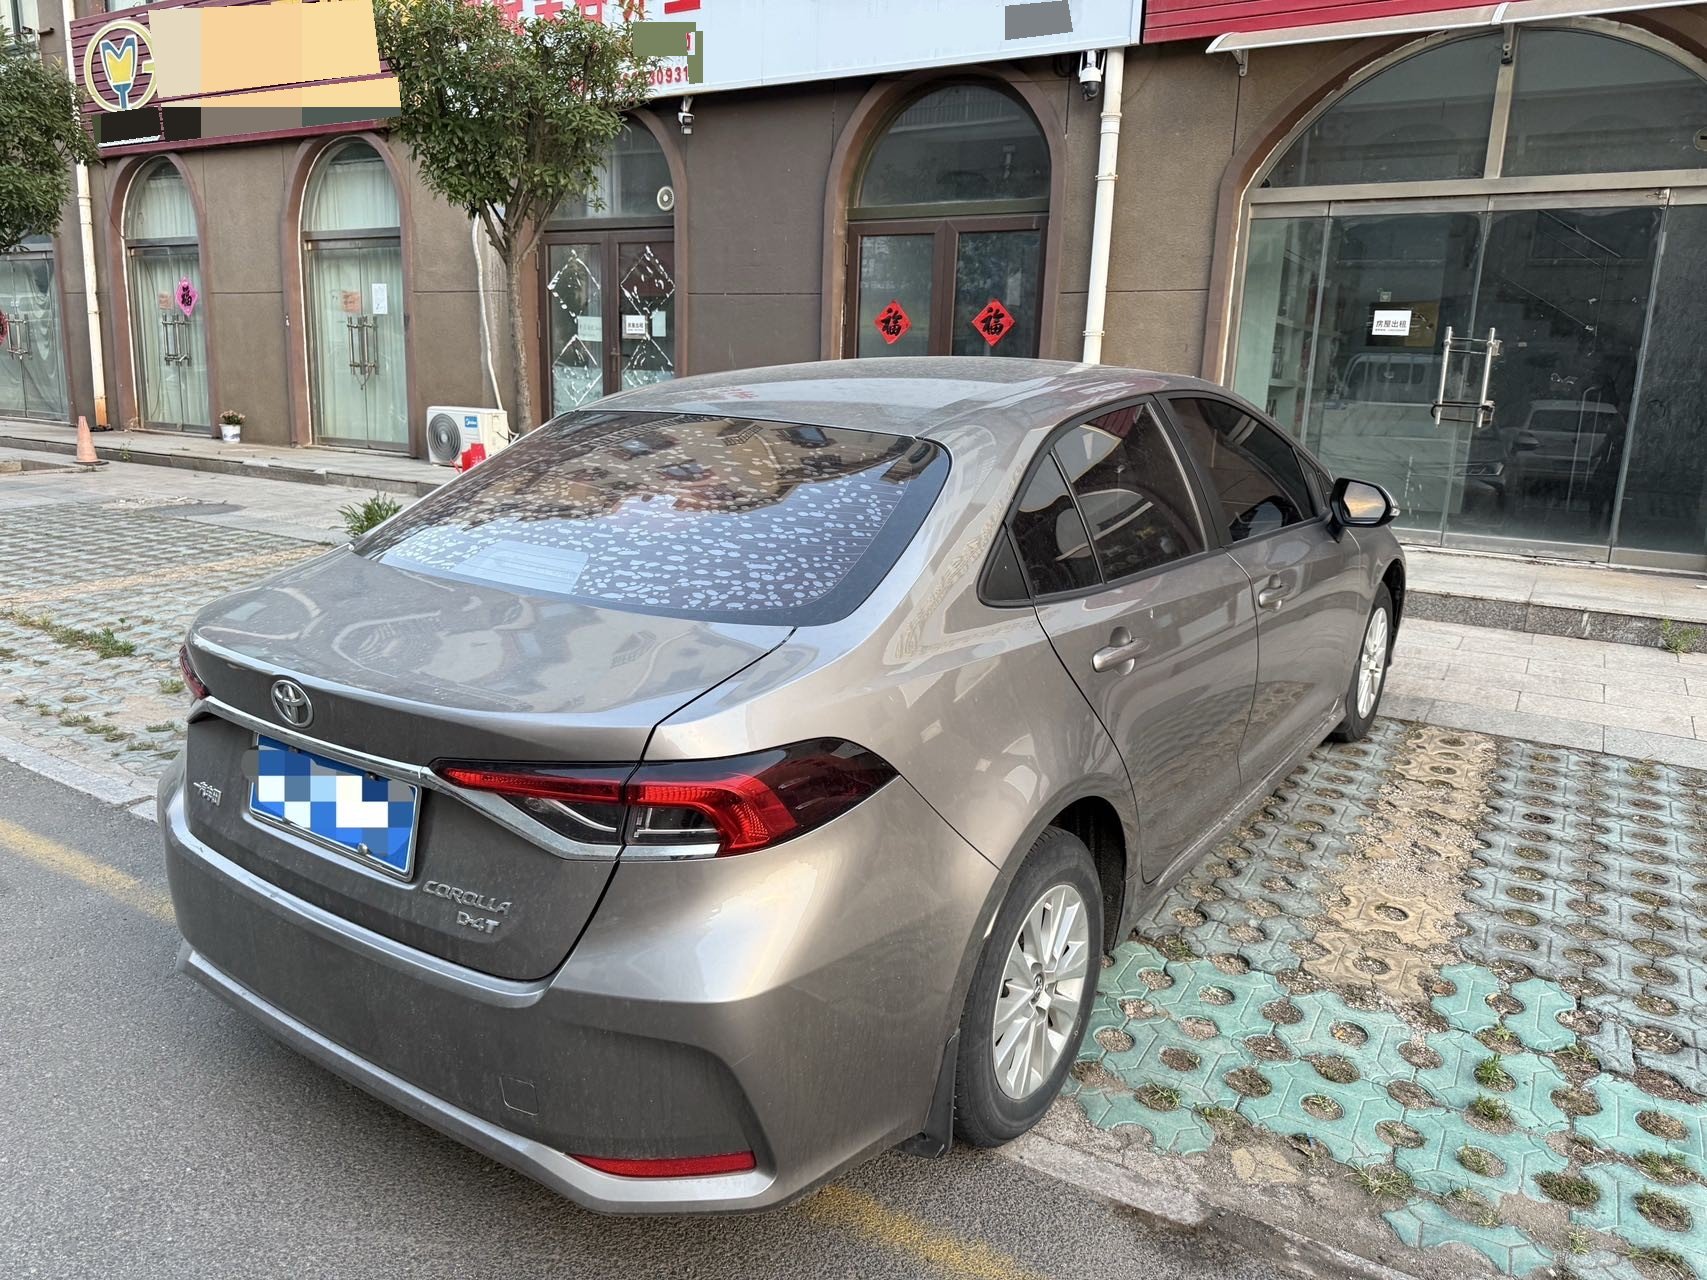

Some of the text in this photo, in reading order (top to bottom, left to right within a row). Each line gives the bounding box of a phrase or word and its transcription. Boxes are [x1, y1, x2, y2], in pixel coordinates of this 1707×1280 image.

[881, 307, 903, 336] 福
[981, 306, 1005, 336] 福
[1375, 319, 1407, 328] 房屋出租
[423, 880, 513, 916] COROLLA
